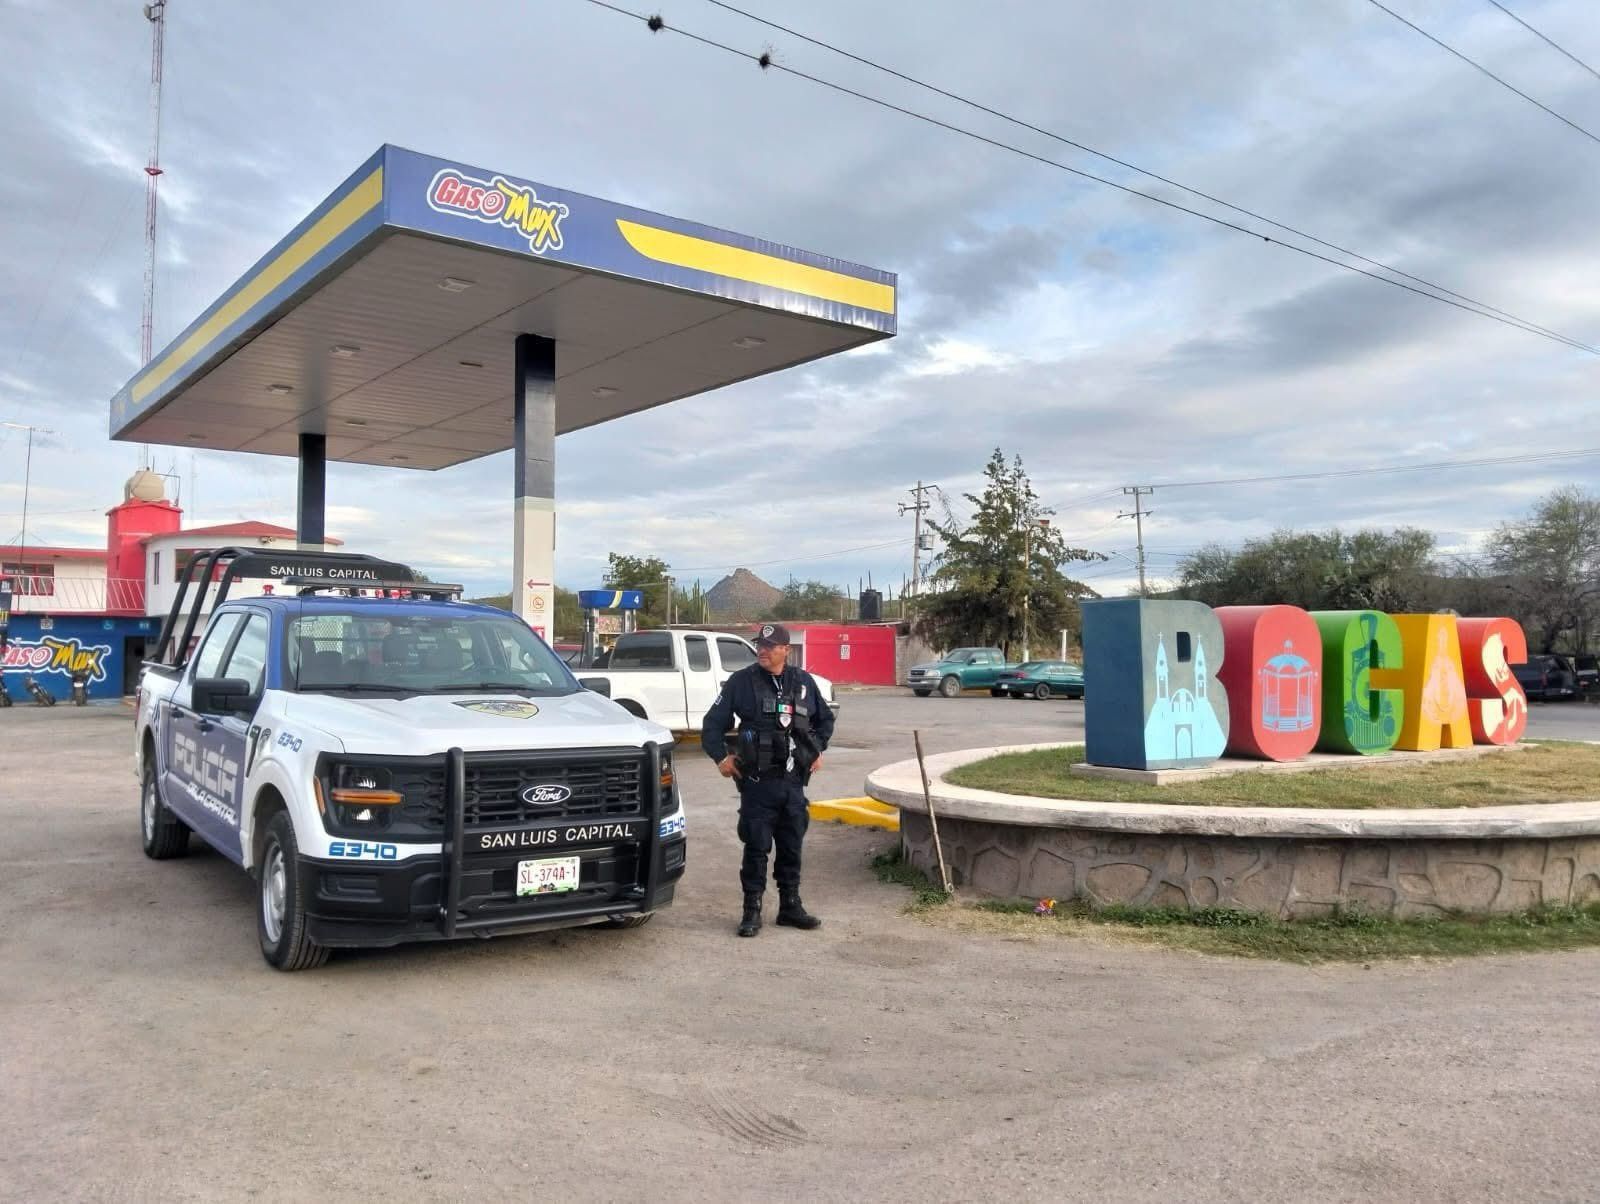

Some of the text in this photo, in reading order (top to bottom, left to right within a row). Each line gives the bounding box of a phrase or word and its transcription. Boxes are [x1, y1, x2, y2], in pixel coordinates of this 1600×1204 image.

[270, 565, 378, 580] SAN LUIS CAPITAL
[633, 595, 640, 605] 4
[1081, 598, 1528, 771] BOCAS
[277, 731, 303, 753] 6340
[174, 731, 239, 805] POLICÍA
[531, 785, 562, 802] Ford
[480, 823, 634, 849] SAN LUIS CAPITAL
[328, 841, 398, 860] 6340
[520, 864, 577, 886] SL-374A-1
